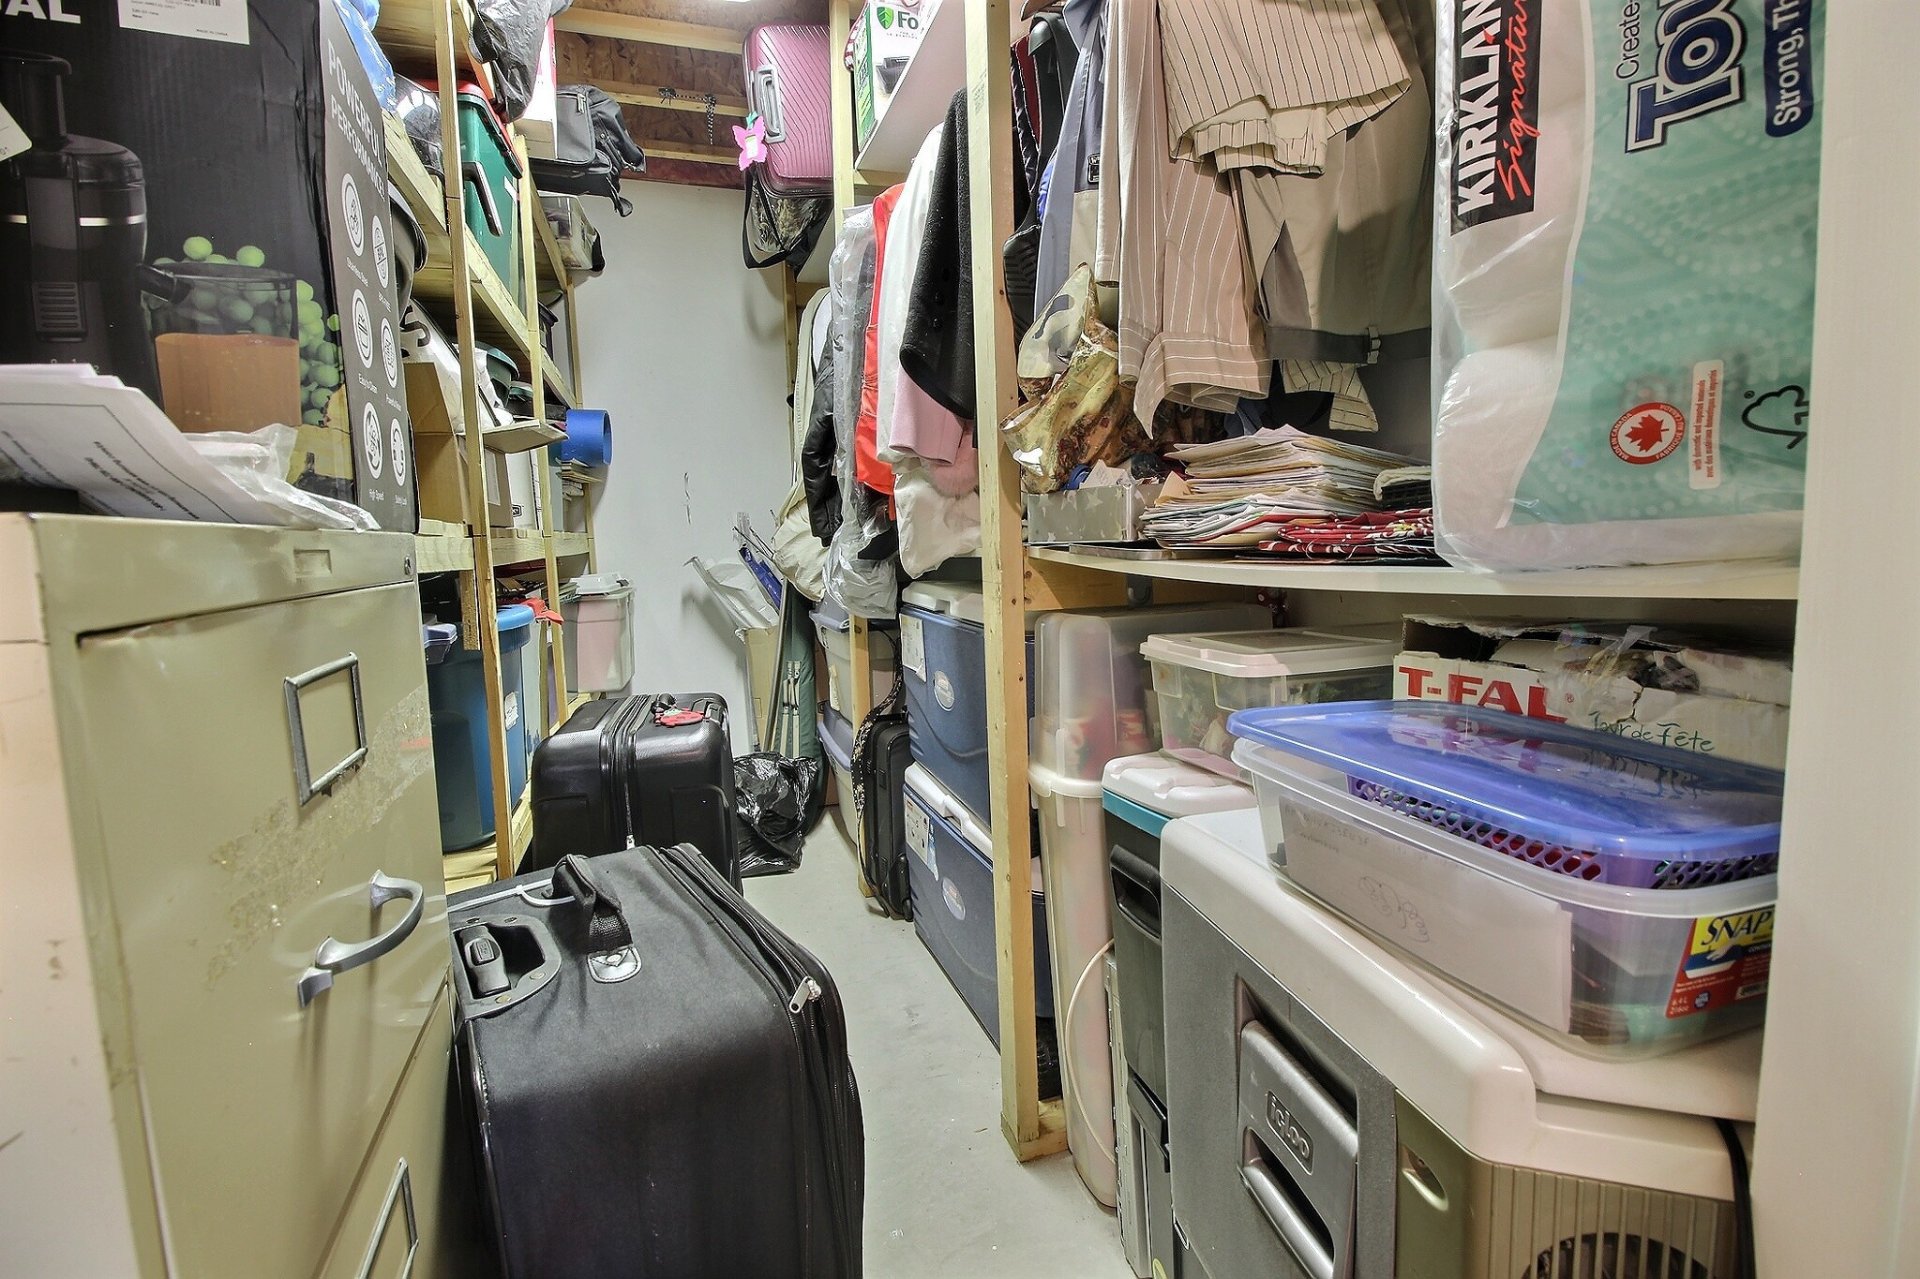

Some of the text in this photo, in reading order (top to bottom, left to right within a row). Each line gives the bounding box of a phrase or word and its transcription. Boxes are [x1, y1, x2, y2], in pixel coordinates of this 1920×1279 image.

[328, 39, 383, 168] POWERFUL
[1773, 27, 1804, 126] Strong,
[1399, 666, 1568, 724] T-FAL
[1631, 724, 1654, 741] de
